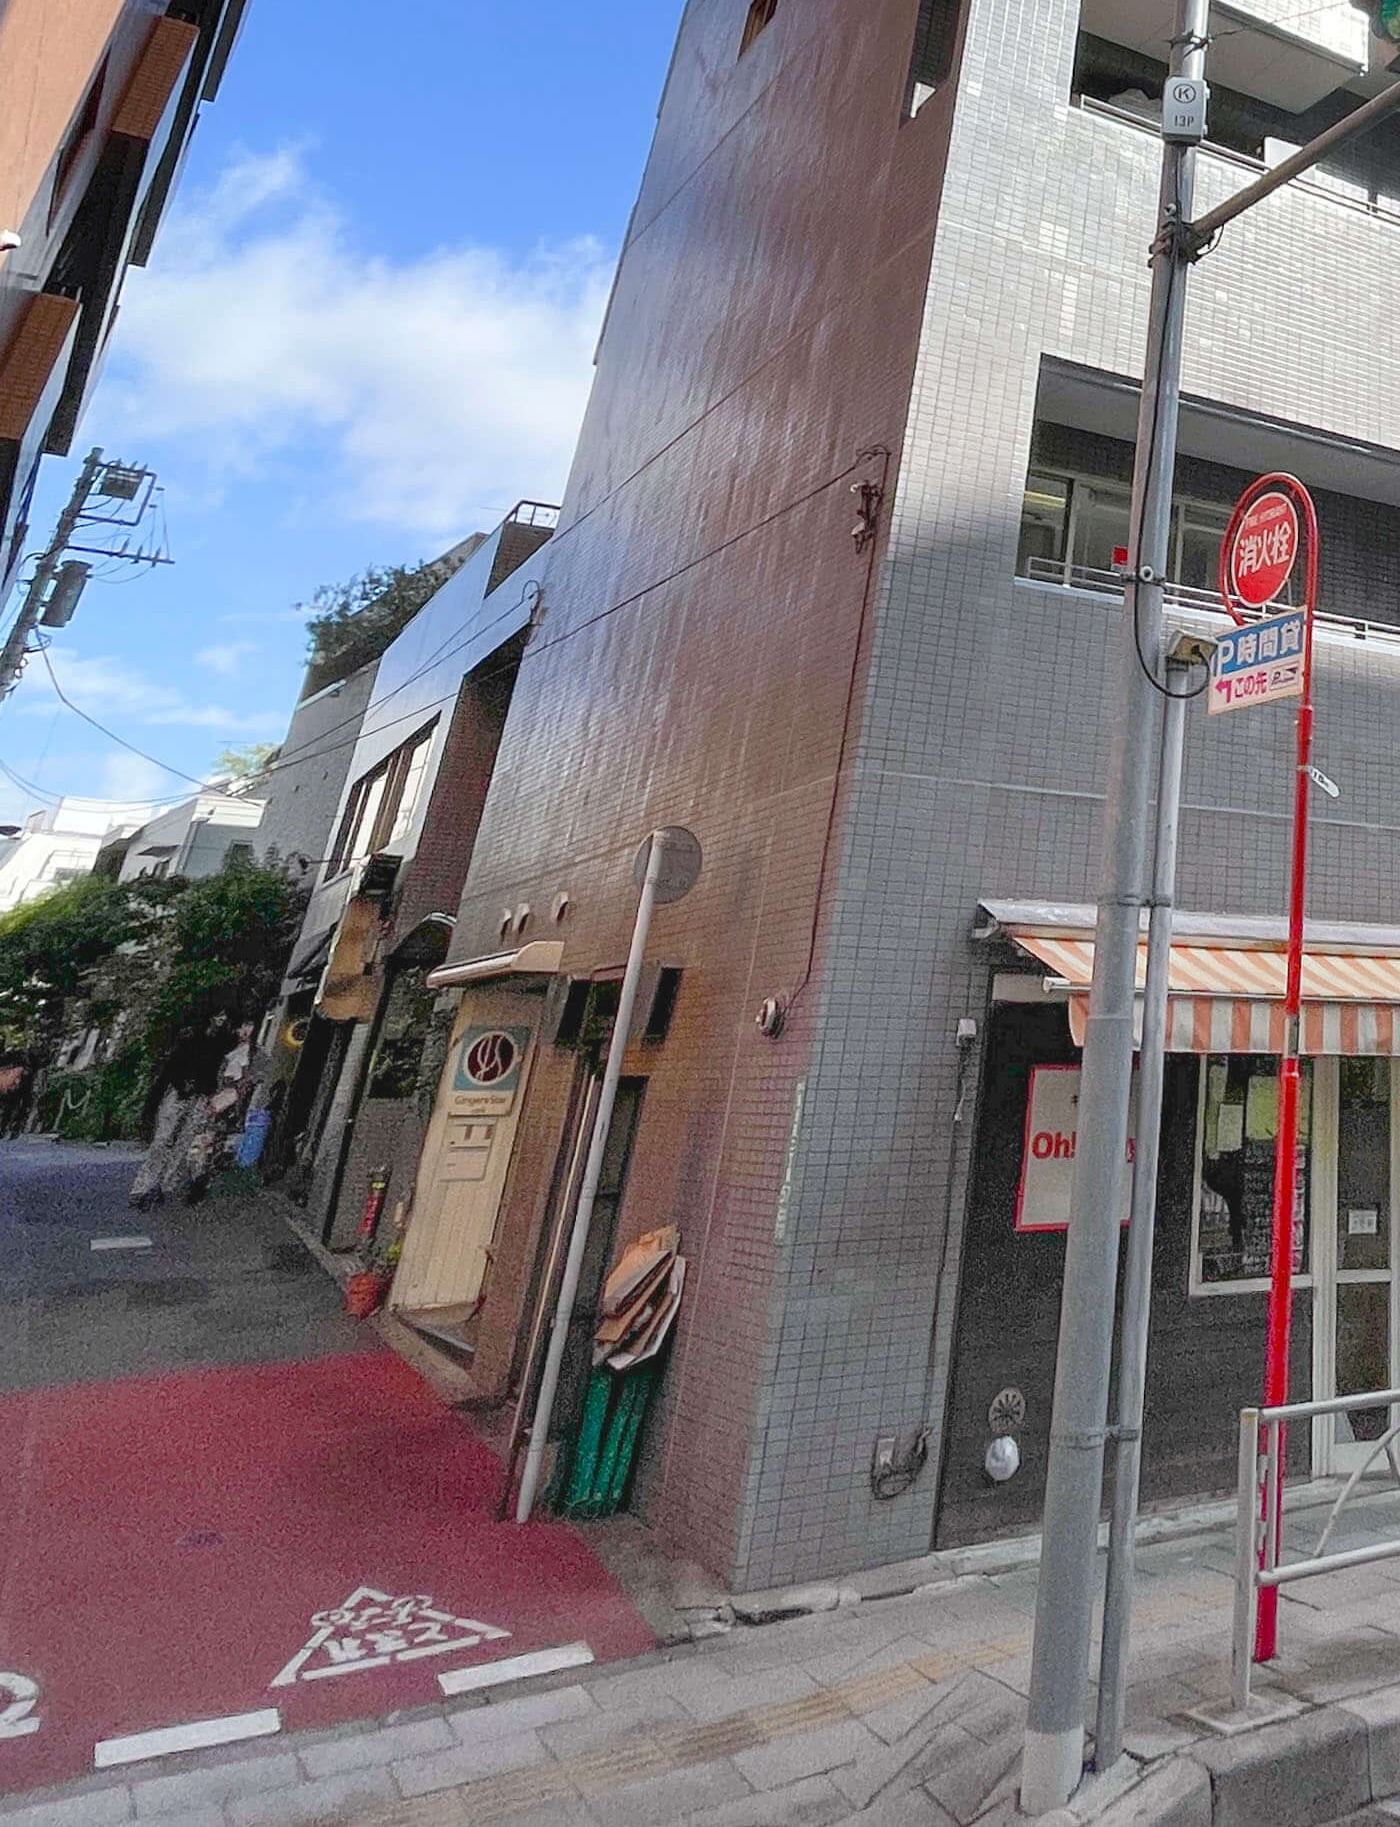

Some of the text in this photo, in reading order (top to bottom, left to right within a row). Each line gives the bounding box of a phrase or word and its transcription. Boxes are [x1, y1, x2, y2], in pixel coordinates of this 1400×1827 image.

[1238, 521, 1292, 578] 消火栓
[1234, 670, 1268, 698] この先
